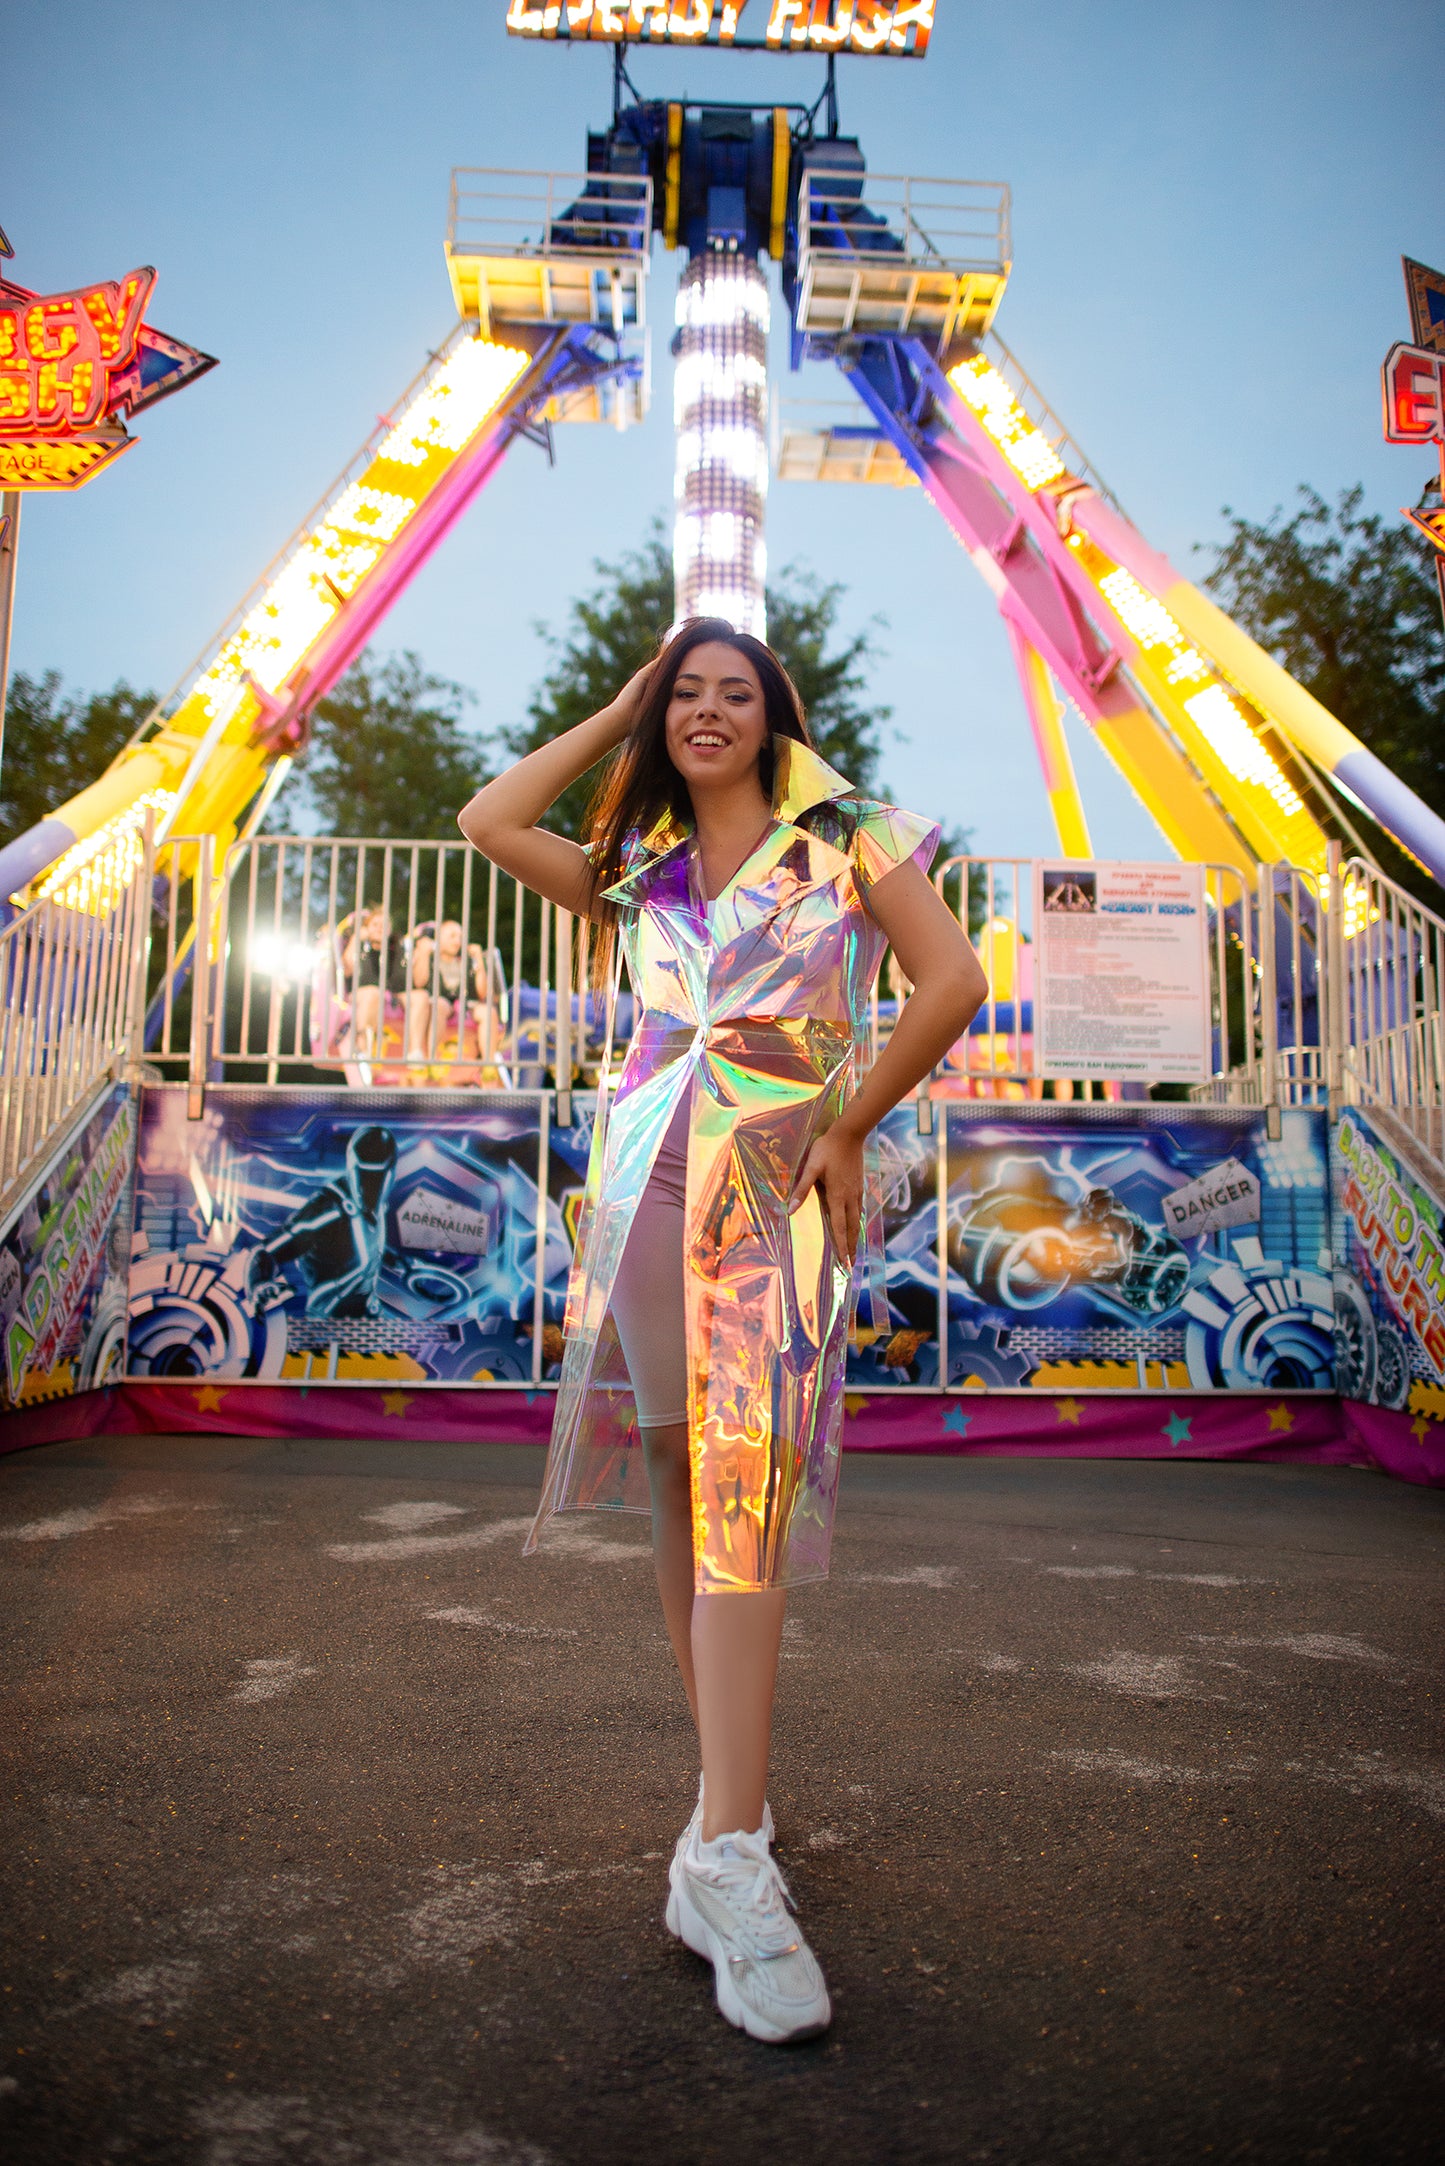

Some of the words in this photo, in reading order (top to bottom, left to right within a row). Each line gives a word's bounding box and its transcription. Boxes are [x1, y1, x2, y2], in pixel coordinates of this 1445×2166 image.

[401, 1210, 484, 1237] ADRENALINE
[1172, 1180, 1255, 1223] DANGER
[1338, 1122, 1386, 1204] BACK
[1385, 1185, 1415, 1244] TO
[1415, 1230, 1445, 1305] TH
[1343, 1180, 1445, 1376] FUTURE
